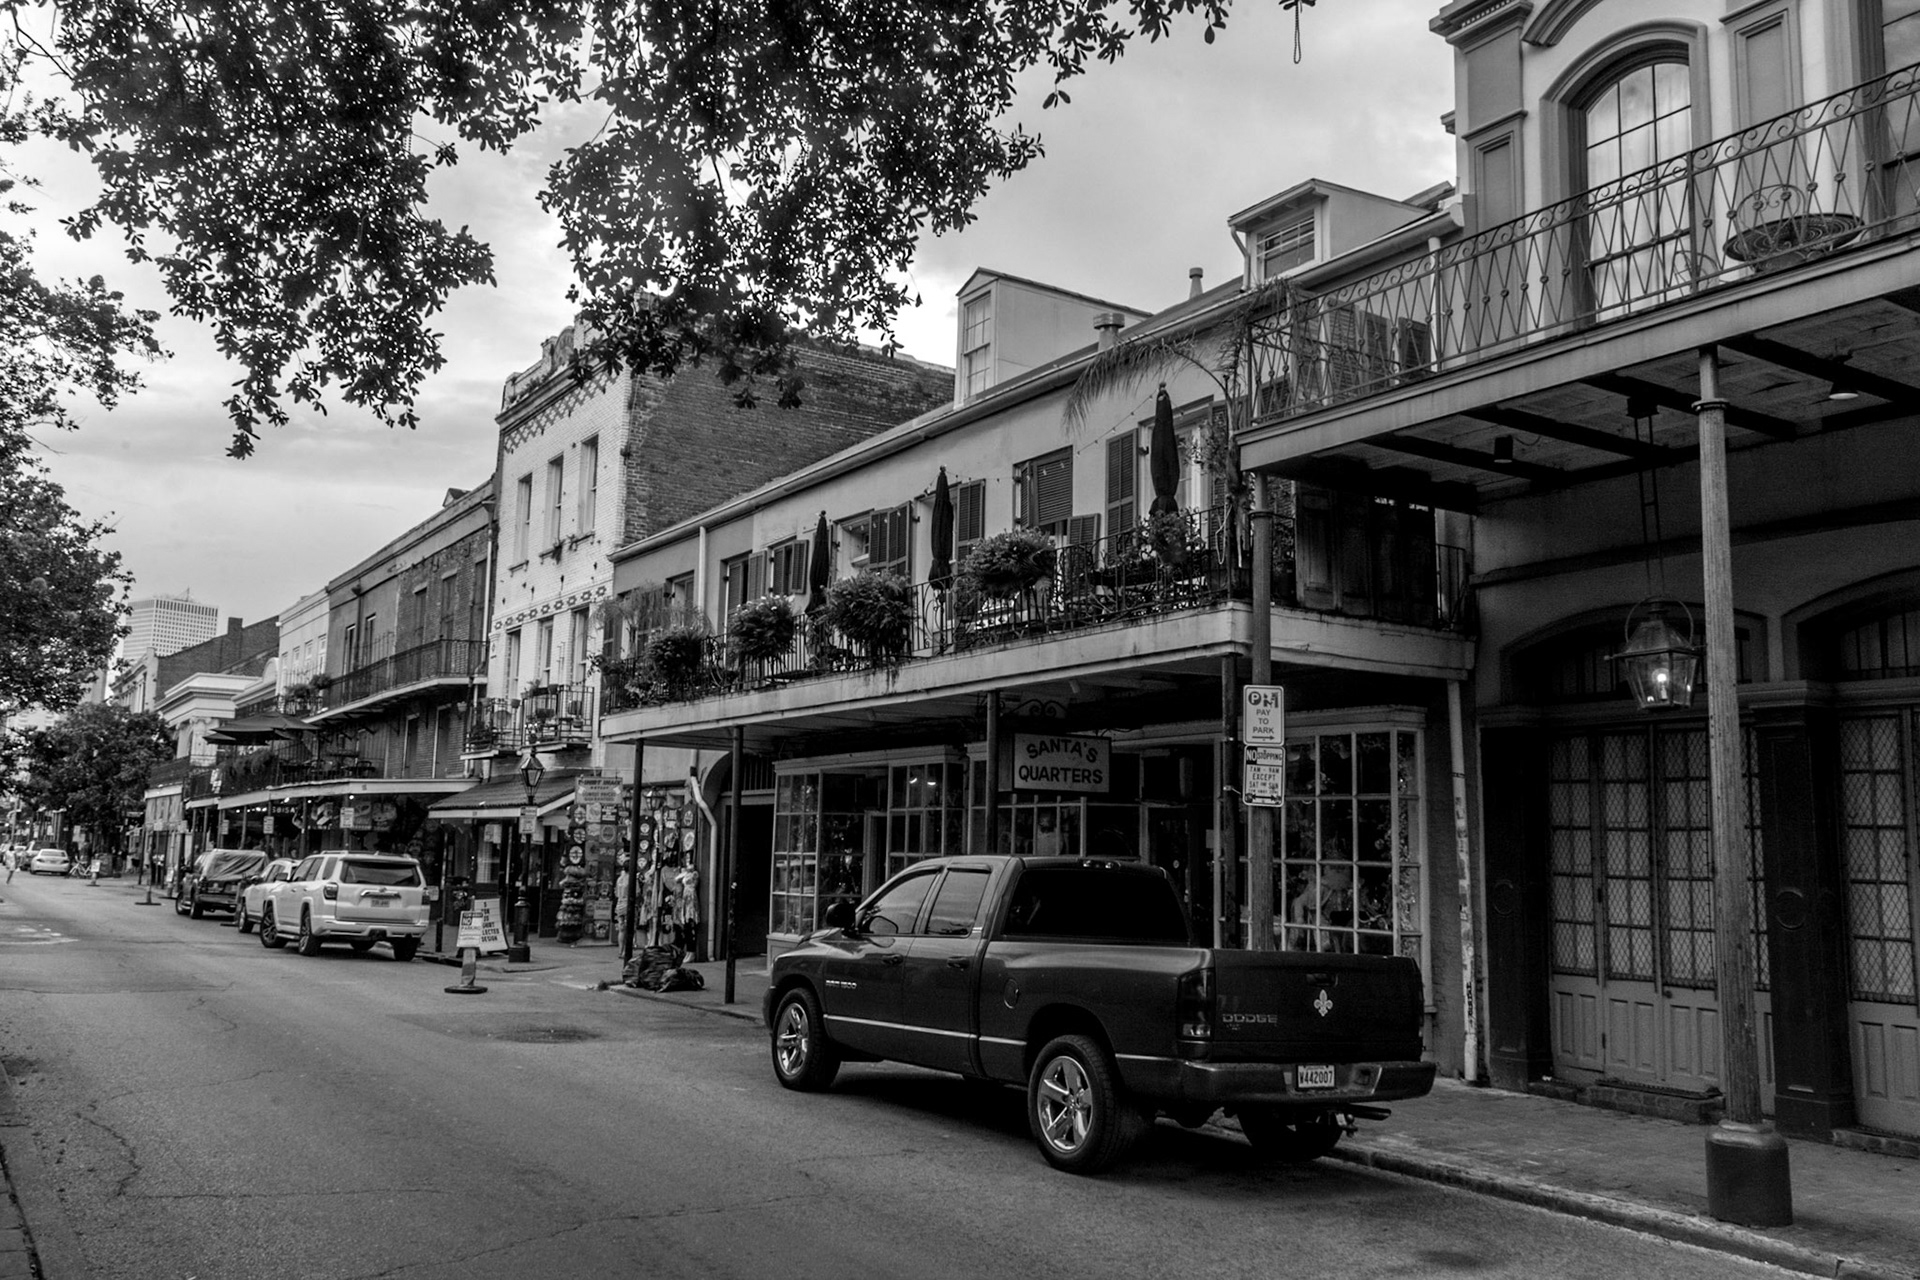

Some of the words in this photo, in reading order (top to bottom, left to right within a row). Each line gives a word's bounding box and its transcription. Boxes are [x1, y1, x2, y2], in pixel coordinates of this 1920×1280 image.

[1258, 717, 1269, 725] TO
[1252, 726, 1275, 734] PARK
[1026, 738, 1099, 764] SANTA'S
[1246, 749, 1257, 761] NO
[1257, 751, 1283, 761] STOPPING
[1018, 765, 1104, 784] QUARTERS
[1252, 773, 1276, 781] EXCEPT
[462, 917, 472, 925] NO
[1222, 1013, 1278, 1023] DODGE
